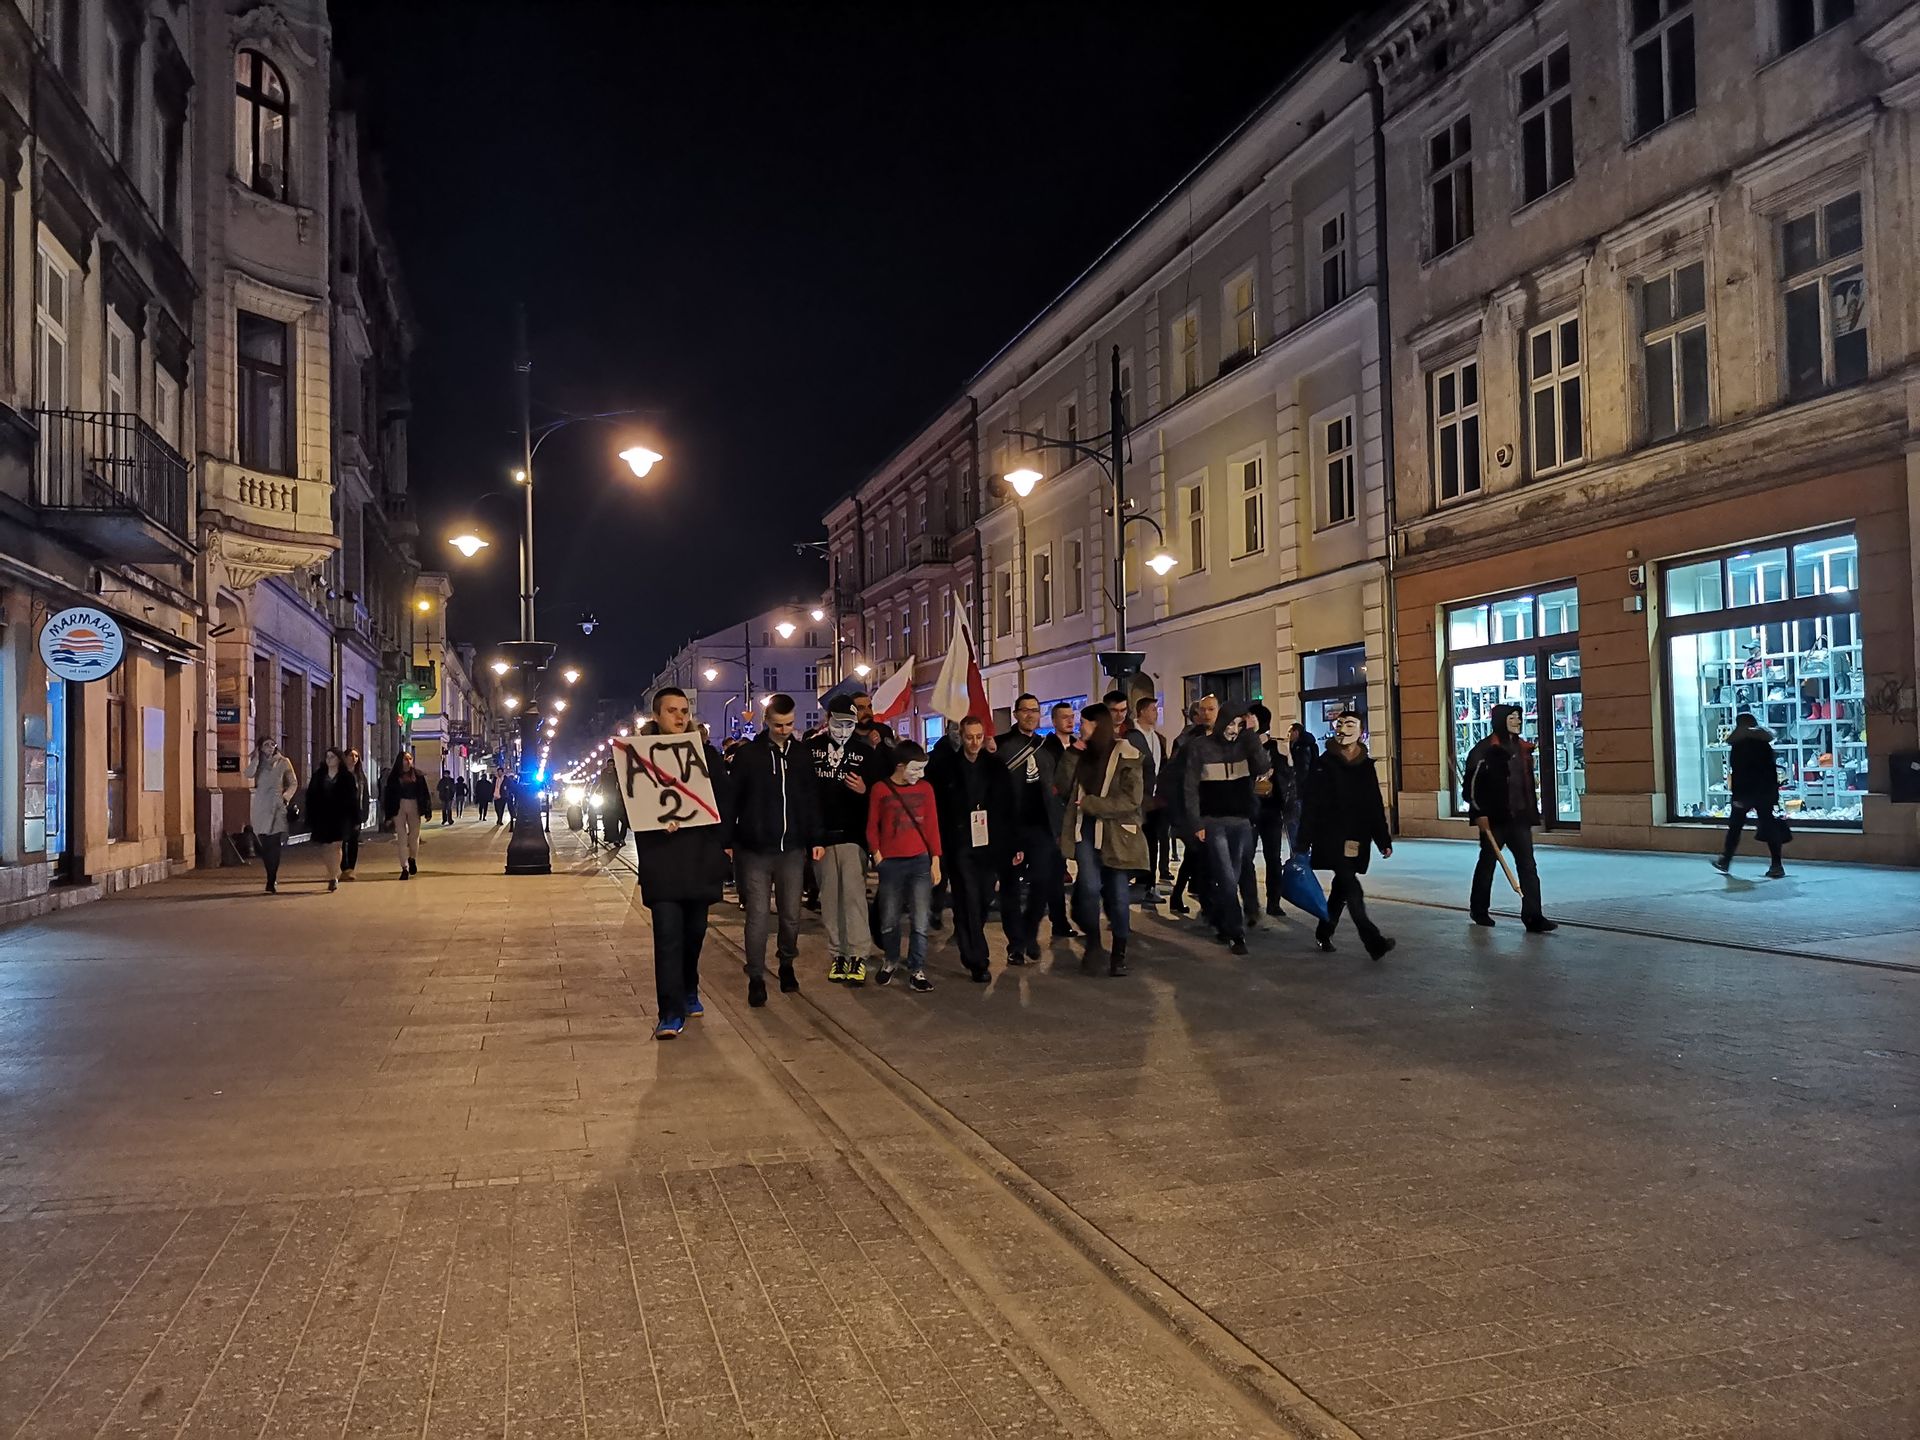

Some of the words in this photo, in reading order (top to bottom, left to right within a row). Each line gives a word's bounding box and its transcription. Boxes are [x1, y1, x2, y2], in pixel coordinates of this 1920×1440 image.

[49, 613, 116, 639] MARMARA
[626, 740, 710, 798] ACTA
[811, 749, 827, 759] Hip
[657, 788, 699, 823] 2
